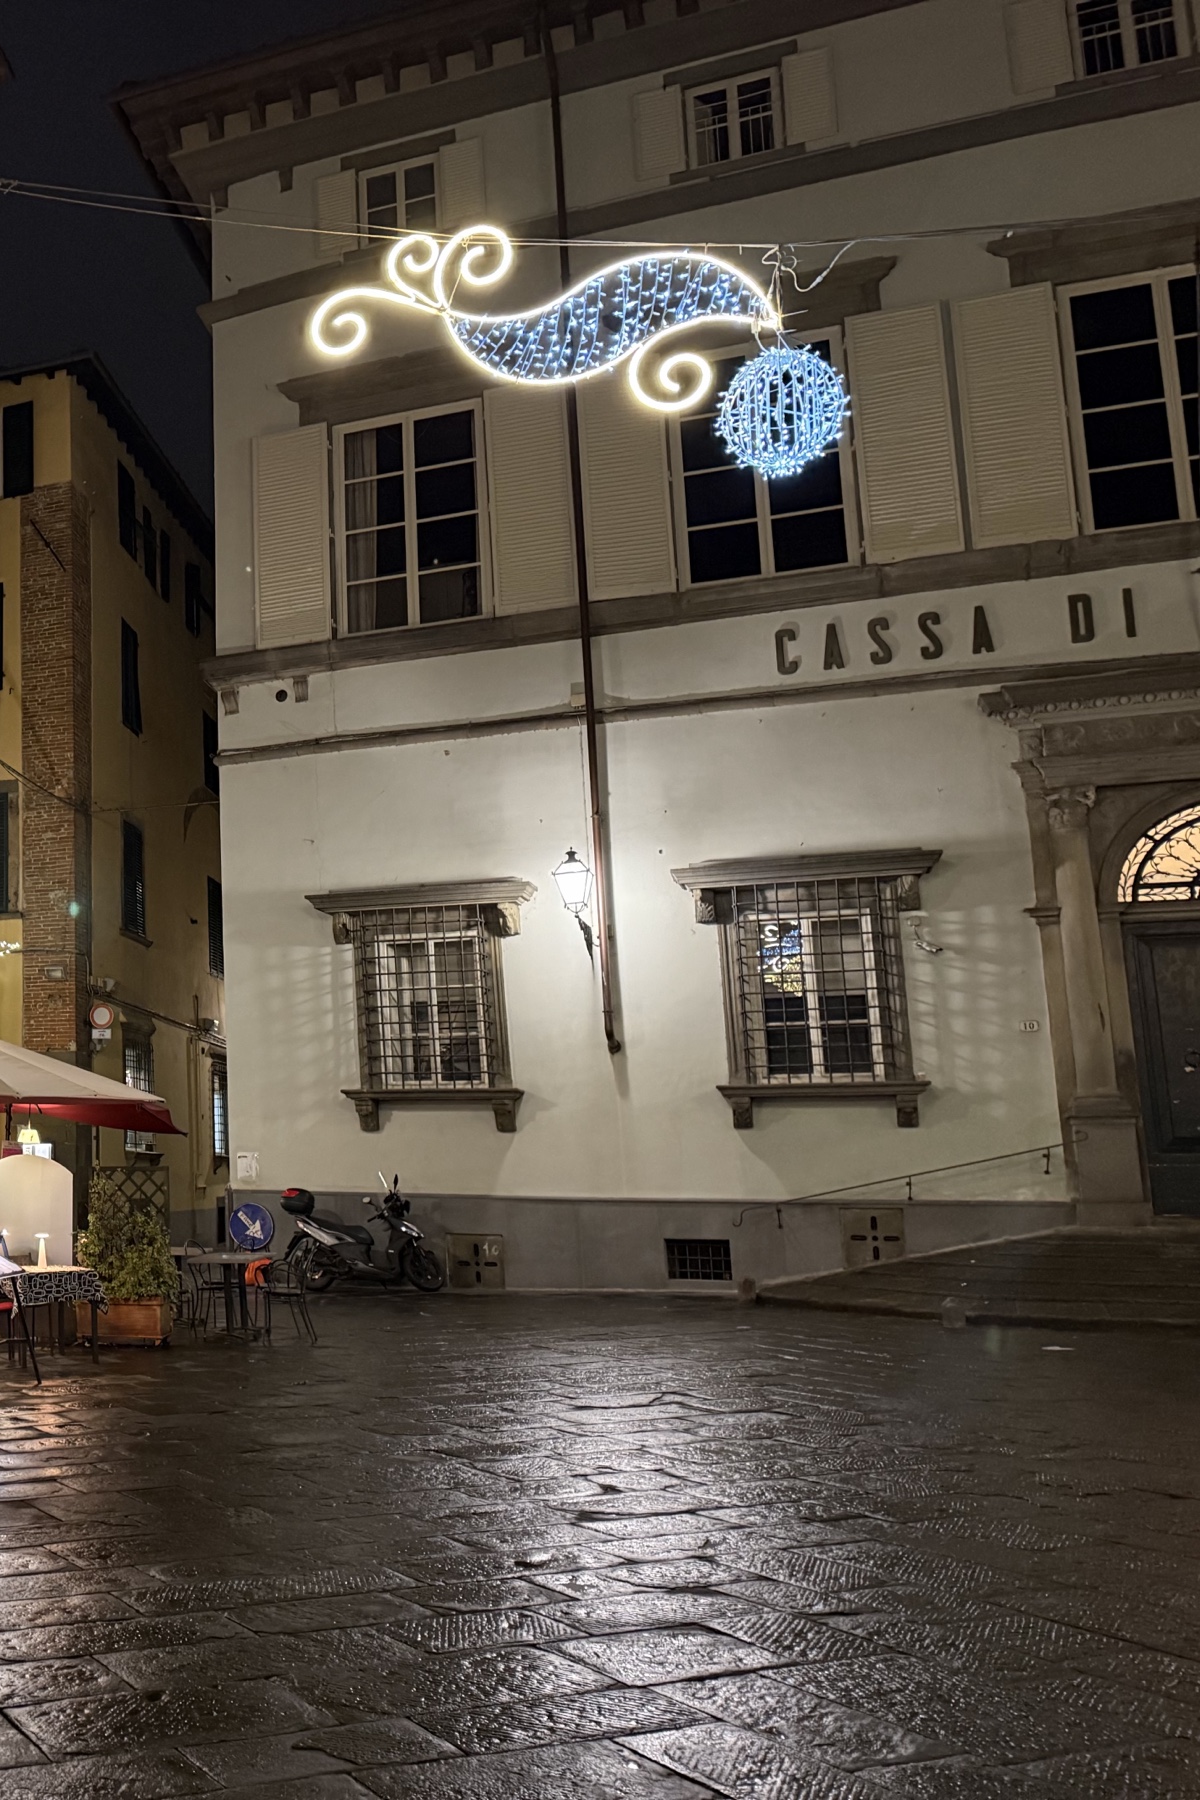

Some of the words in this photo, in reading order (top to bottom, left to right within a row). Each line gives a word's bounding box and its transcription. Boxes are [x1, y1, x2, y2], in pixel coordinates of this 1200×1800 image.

[774, 605, 995, 675] CASSA
[1067, 587, 1137, 644] DI
[1023, 1022, 1035, 1030] 10
